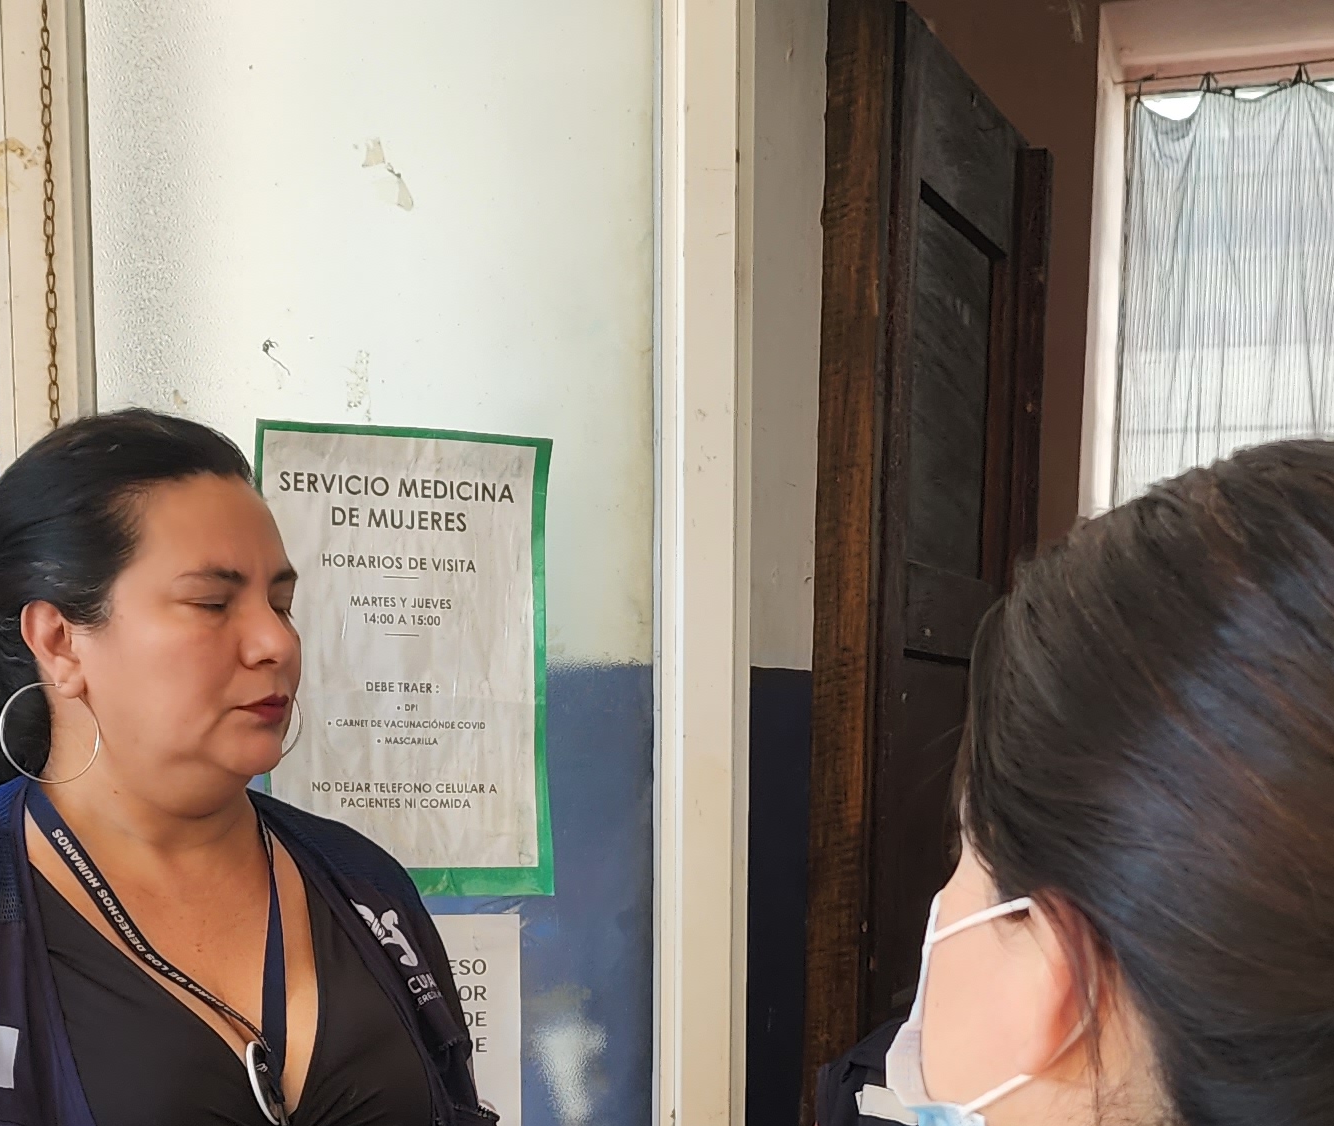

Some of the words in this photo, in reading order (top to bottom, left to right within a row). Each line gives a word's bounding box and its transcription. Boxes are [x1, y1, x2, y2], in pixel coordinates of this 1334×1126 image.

[279, 471, 390, 497] SERVICIO
[397, 477, 514, 504] MEDICINA
[331, 506, 360, 527] DE
[367, 508, 467, 532] MUJERES
[322, 553, 402, 570] HORARIOS
[408, 557, 427, 571] DE
[432, 558, 476, 573] VISITA
[350, 596, 396, 608] MARTES
[400, 597, 407, 608] Y
[411, 598, 452, 609] JUEVES
[363, 612, 394, 625] 14:00
[398, 614, 407, 625] A
[411, 615, 441, 626] 15:00
[366, 681, 395, 693] DEBE
[397, 682, 432, 694] TRAER
[404, 703, 419, 712] DPI
[335, 718, 368, 728] CARNET
[371, 719, 382, 728] DE
[457, 721, 486, 730] COVID
[384, 737, 438, 746] MASCARILLA
[311, 781, 331, 792] NO
[335, 781, 371, 793] DEJAR
[374, 782, 432, 794] TELEFONO
[435, 783, 485, 794] CELULAR
[488, 783, 497, 794] A
[340, 797, 401, 809] PACIENTES
[404, 798, 416, 809] NI
[420, 798, 472, 809] COMIDA
[51, 828, 101, 888] HUMANOS
[97, 888, 147, 952] DERECHOS
[145, 953, 169, 971] LOS
